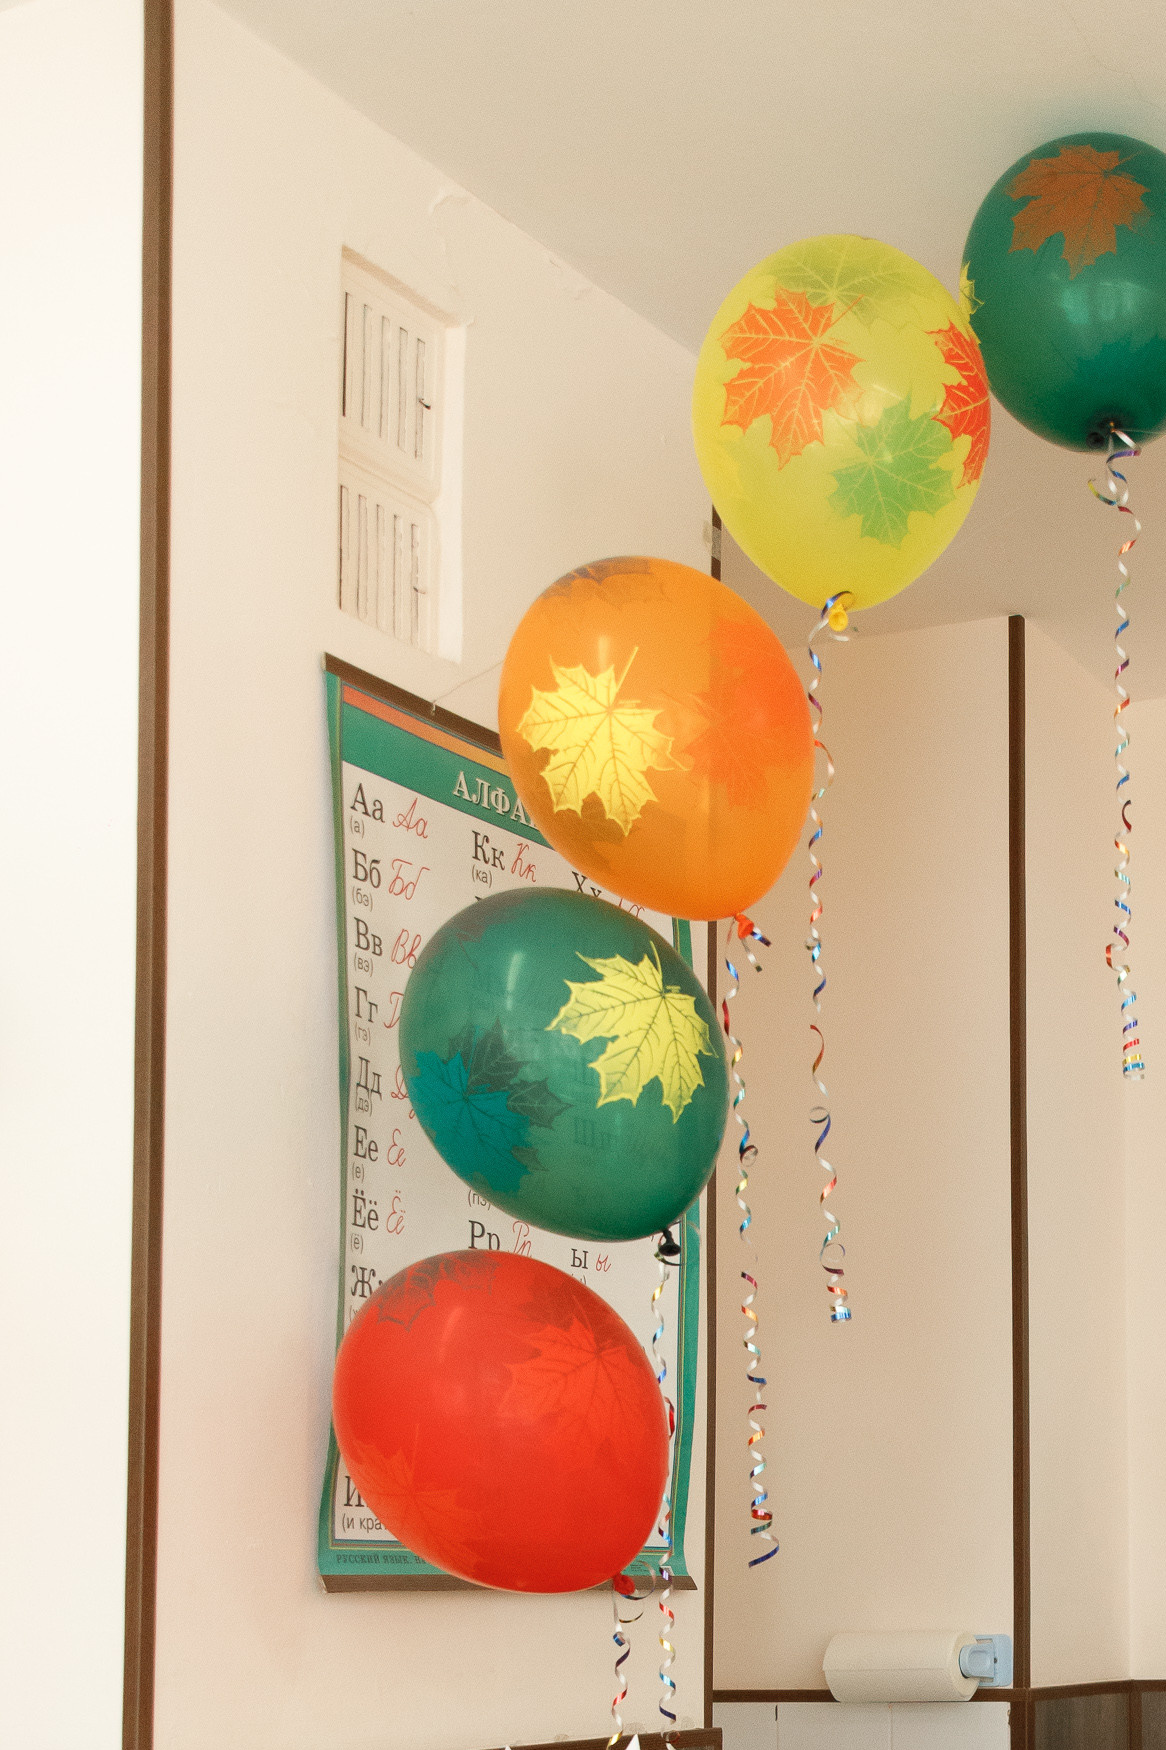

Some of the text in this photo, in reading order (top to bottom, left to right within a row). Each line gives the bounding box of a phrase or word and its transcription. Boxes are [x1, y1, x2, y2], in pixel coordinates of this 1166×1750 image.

[350, 783, 385, 823] Аа
[352, 848, 381, 888] Бб
[472, 830, 505, 870] Кк
[354, 917, 382, 956] Вв
[355, 986, 378, 1023] Гг
[356, 1056, 382, 1100] Дд
[354, 1125, 378, 1162] Ее
[352, 1188, 379, 1231] Ёё
